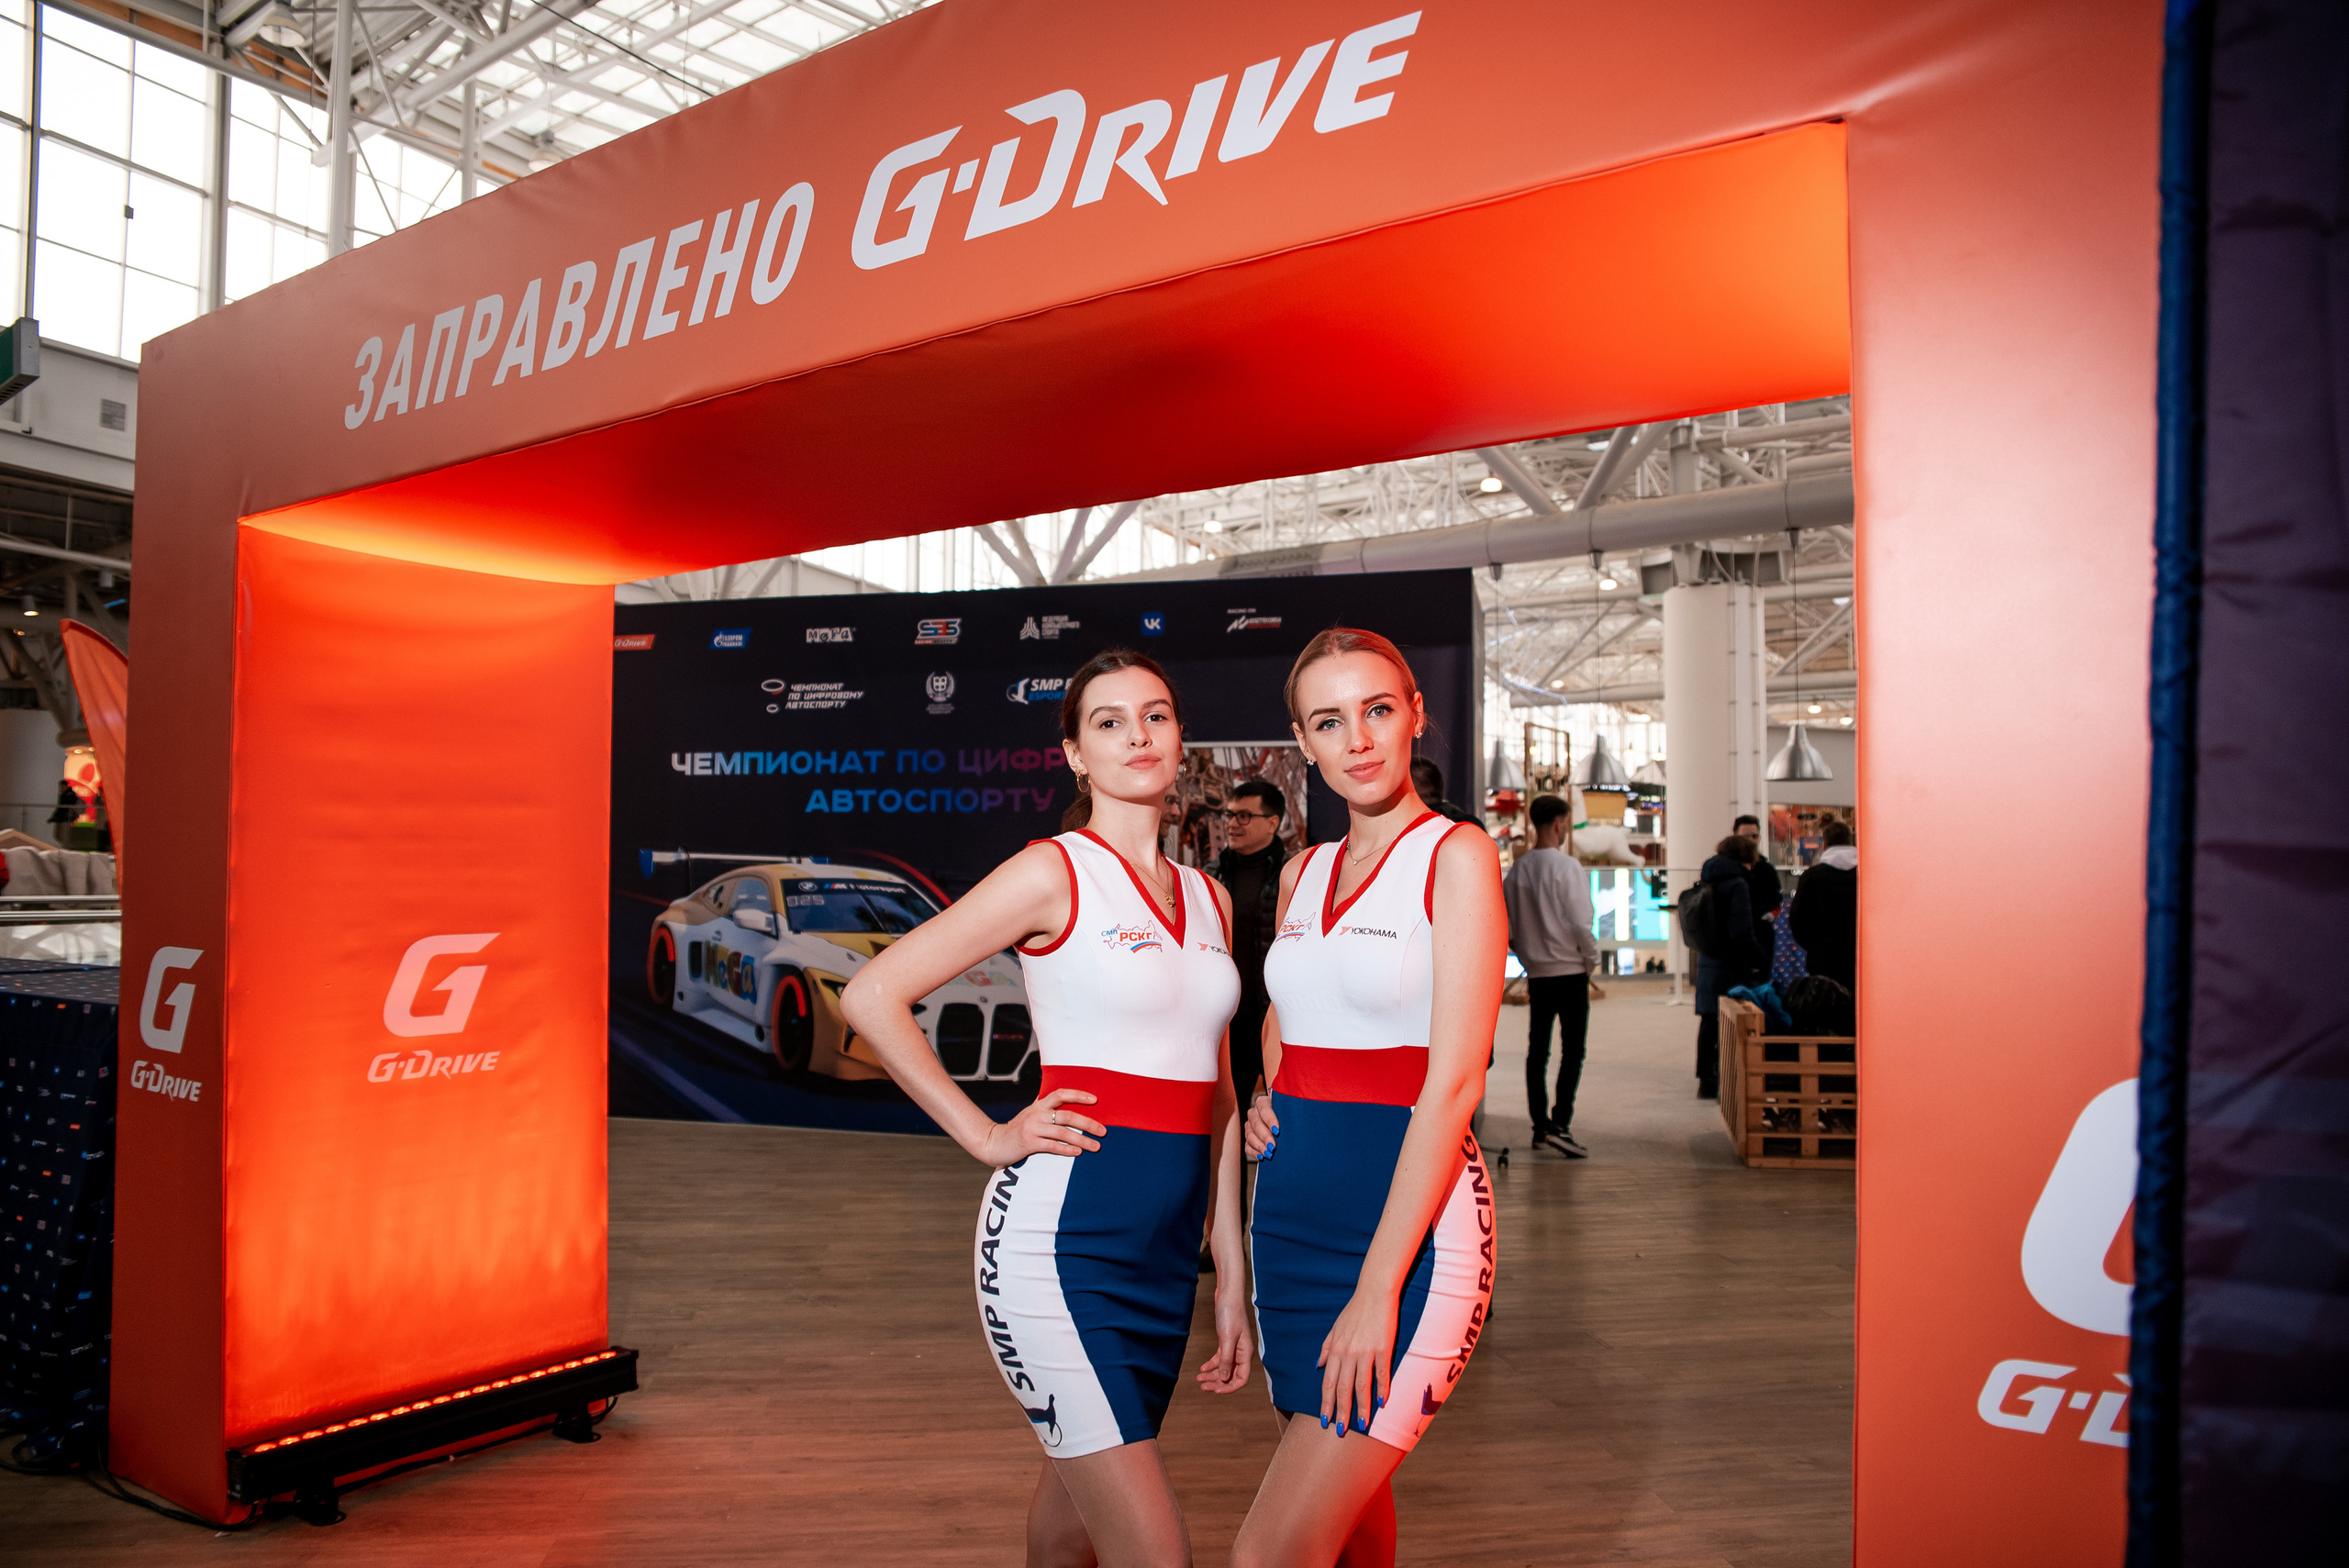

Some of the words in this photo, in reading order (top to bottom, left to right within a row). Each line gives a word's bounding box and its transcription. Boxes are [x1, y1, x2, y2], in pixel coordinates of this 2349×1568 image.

[344, 182, 815, 430] ЗАПРАВЛЕНО
[787, 692, 800, 701] ПО
[803, 691, 864, 701] ЦИФРОВОМУ
[790, 683, 844, 692] ЧЕМПИОНАТ
[1030, 679, 1063, 691] SMP
[785, 700, 846, 710] АВТОСПОРТУ
[671, 750, 885, 776] ЧЕМПИОНАТ
[896, 749, 946, 774] ПО
[957, 747, 1065, 776] ЦИФР
[804, 787, 1055, 814] АВТОСПОРТУ
[1101, 929, 1119, 938] СМП
[1119, 932, 1153, 943] РСКГ
[1351, 927, 1397, 940] YOKOHAMA
[383, 932, 501, 1038] G
[140, 946, 205, 1054] G
[980, 1154, 1029, 1296] RACIN
[1461, 1134, 1494, 1294] RACING
[985, 1304, 1036, 1393] SMP
[1446, 1302, 1484, 1385] SMP
